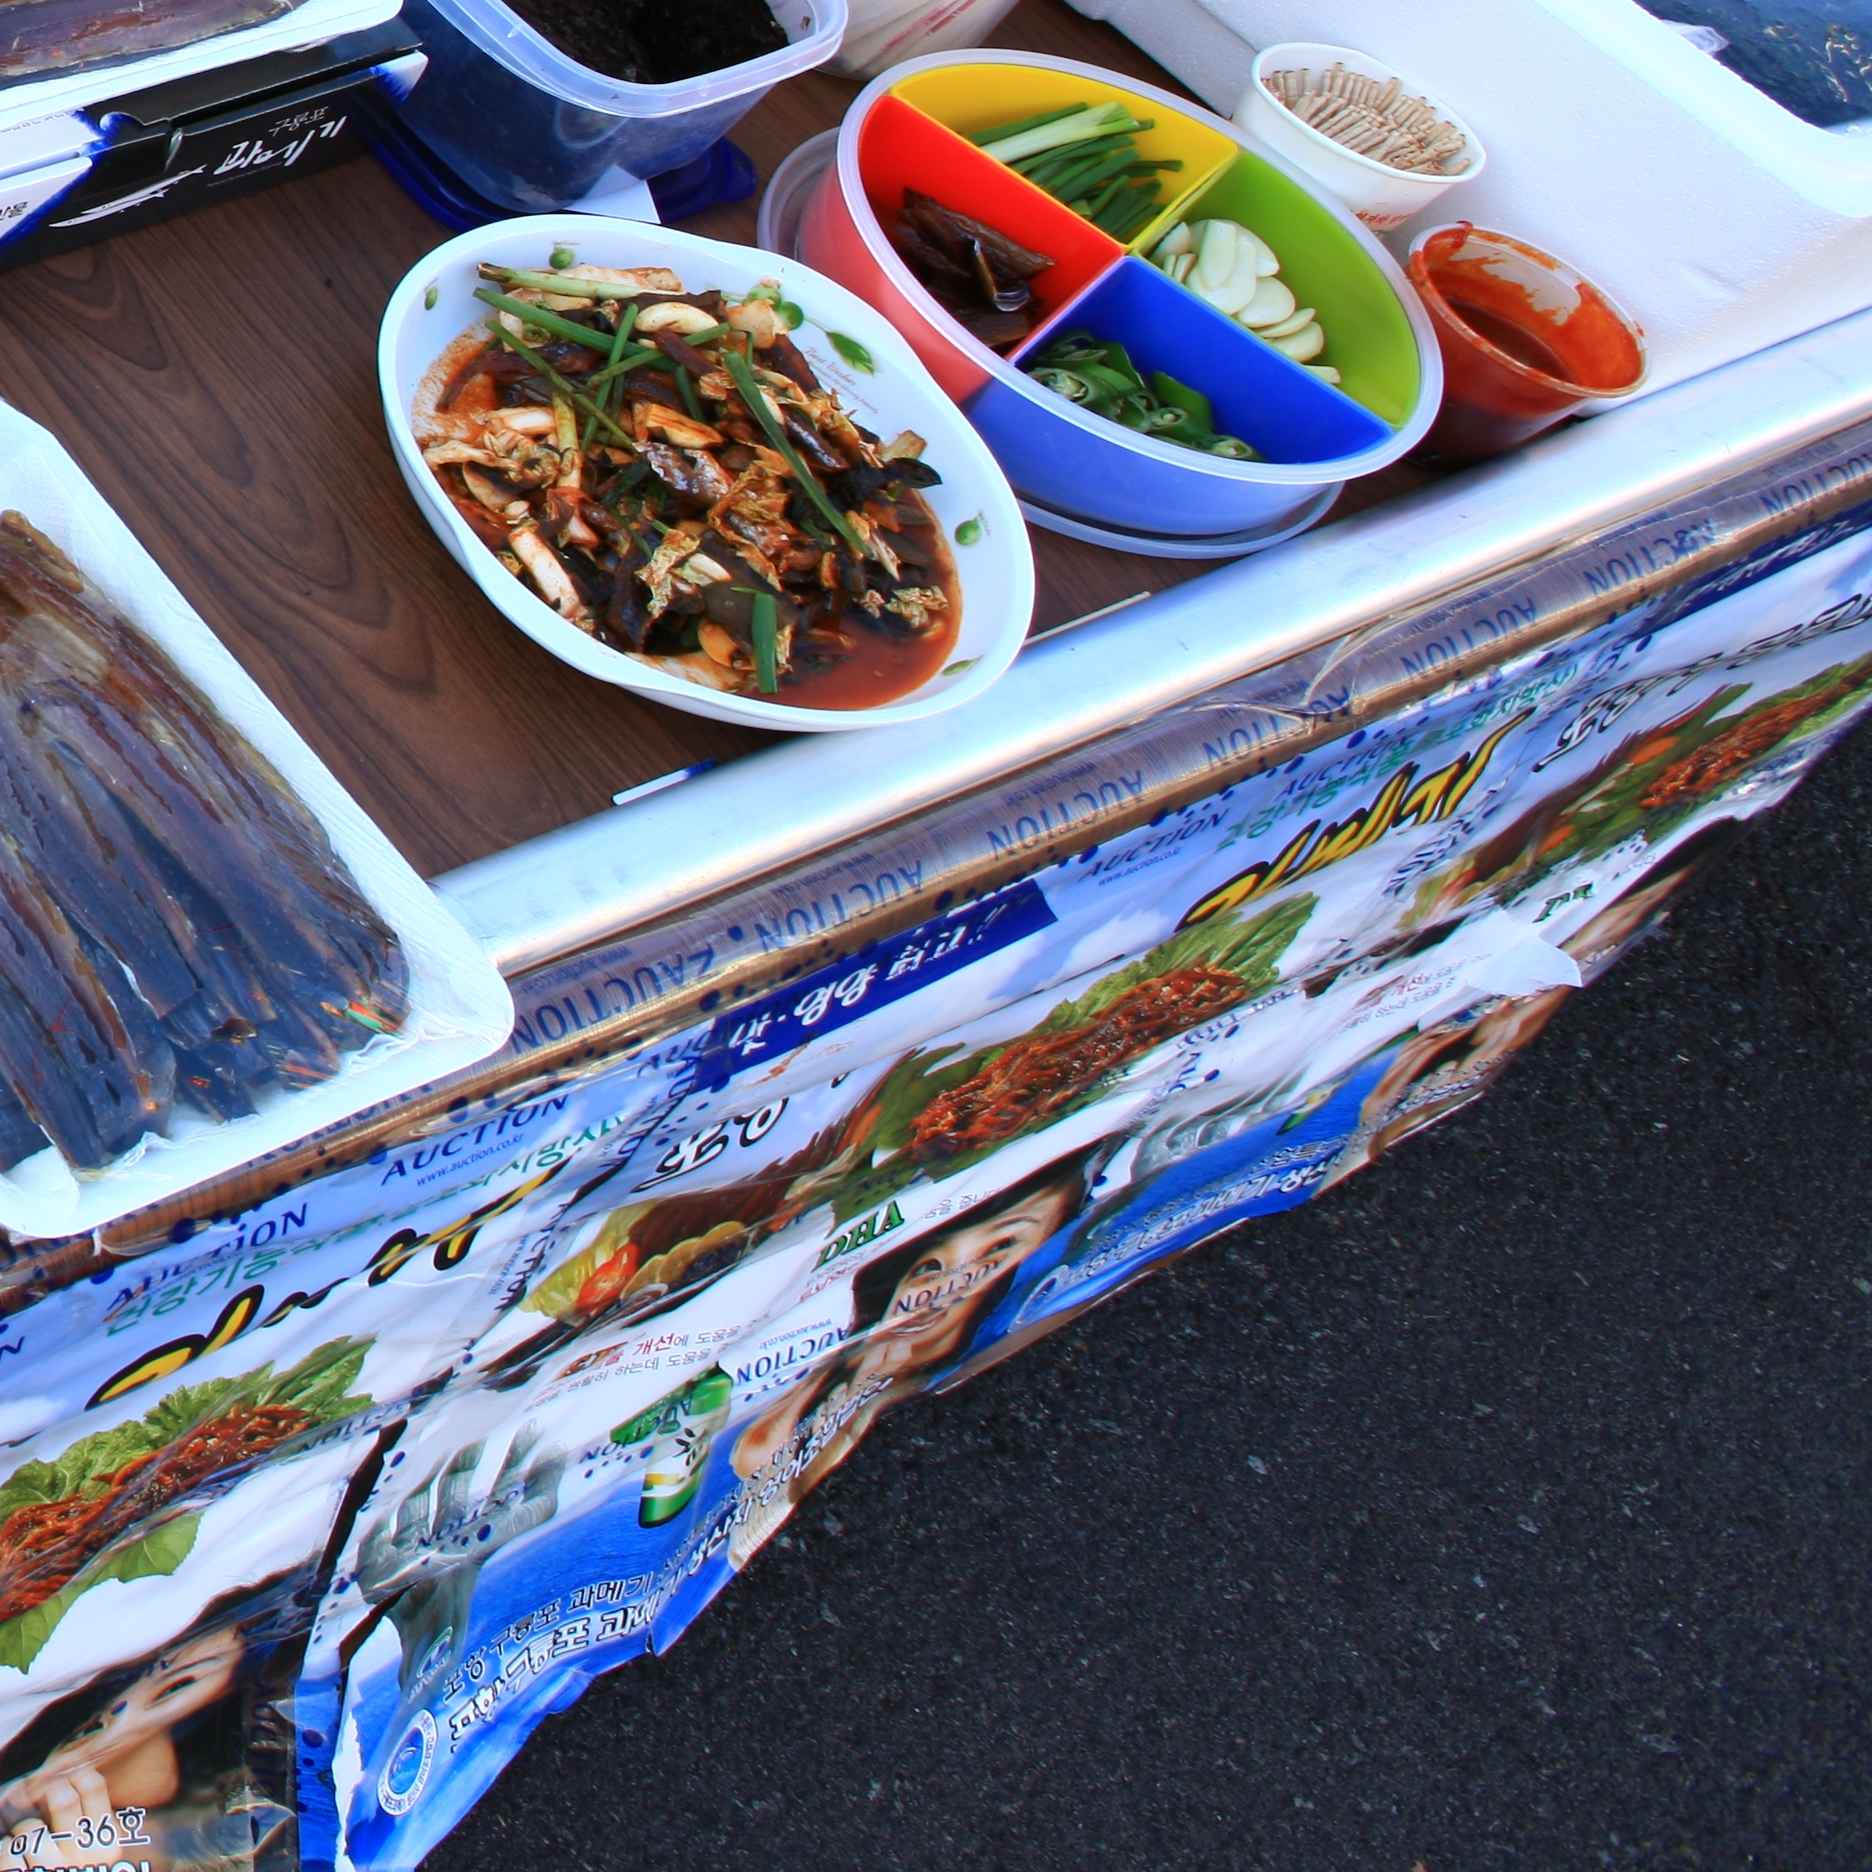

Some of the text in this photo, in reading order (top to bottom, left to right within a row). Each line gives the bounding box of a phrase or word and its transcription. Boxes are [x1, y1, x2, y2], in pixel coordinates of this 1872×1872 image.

[213, 115, 349, 176] 과메기
[985, 770, 1145, 862] AUCTION
[380, 1090, 573, 1186] AUCTION
[814, 1200, 907, 1274] DHA
[9, 1806, 153, 1860] 07-36호
